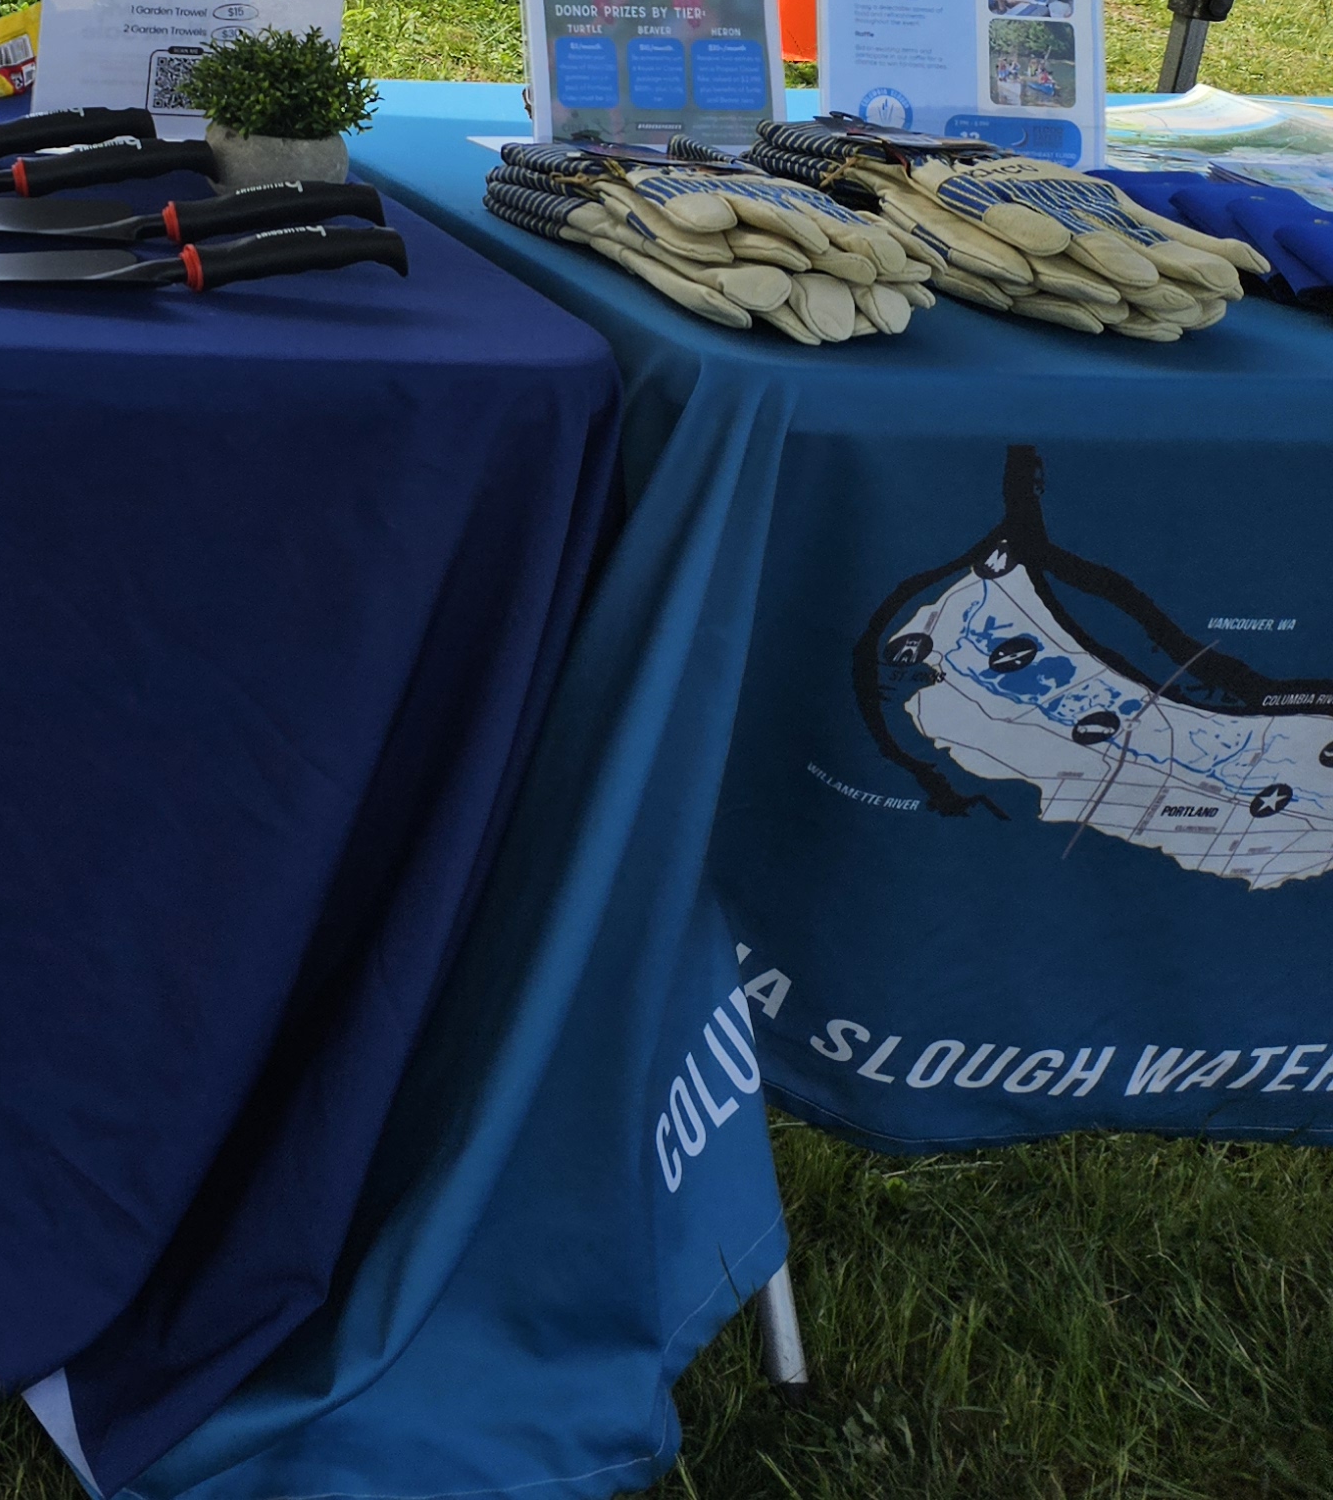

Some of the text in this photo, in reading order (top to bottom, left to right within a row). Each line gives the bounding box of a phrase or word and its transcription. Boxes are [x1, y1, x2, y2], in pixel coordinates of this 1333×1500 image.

[136, 5, 173, 16] Garden
[175, 7, 207, 17] Trowel
[228, 6, 245, 18] $15
[555, 4, 706, 20] DONOR PRIZES BY TIER:
[123, 24, 130, 33] 2
[130, 24, 168, 35] Garden
[170, 26, 207, 37] Trowels
[567, 24, 741, 37] TURTLE BEAVER HERON
[1276, 618, 1297, 631] WA
[1262, 693, 1315, 707] COLUMBIA
[806, 760, 921, 812] WILLAMETTE RIVER
[1160, 805, 1219, 818] PORTLAND
[656, 942, 792, 1194] COLUA
[810, 1017, 1116, 1098] SLOUGH
